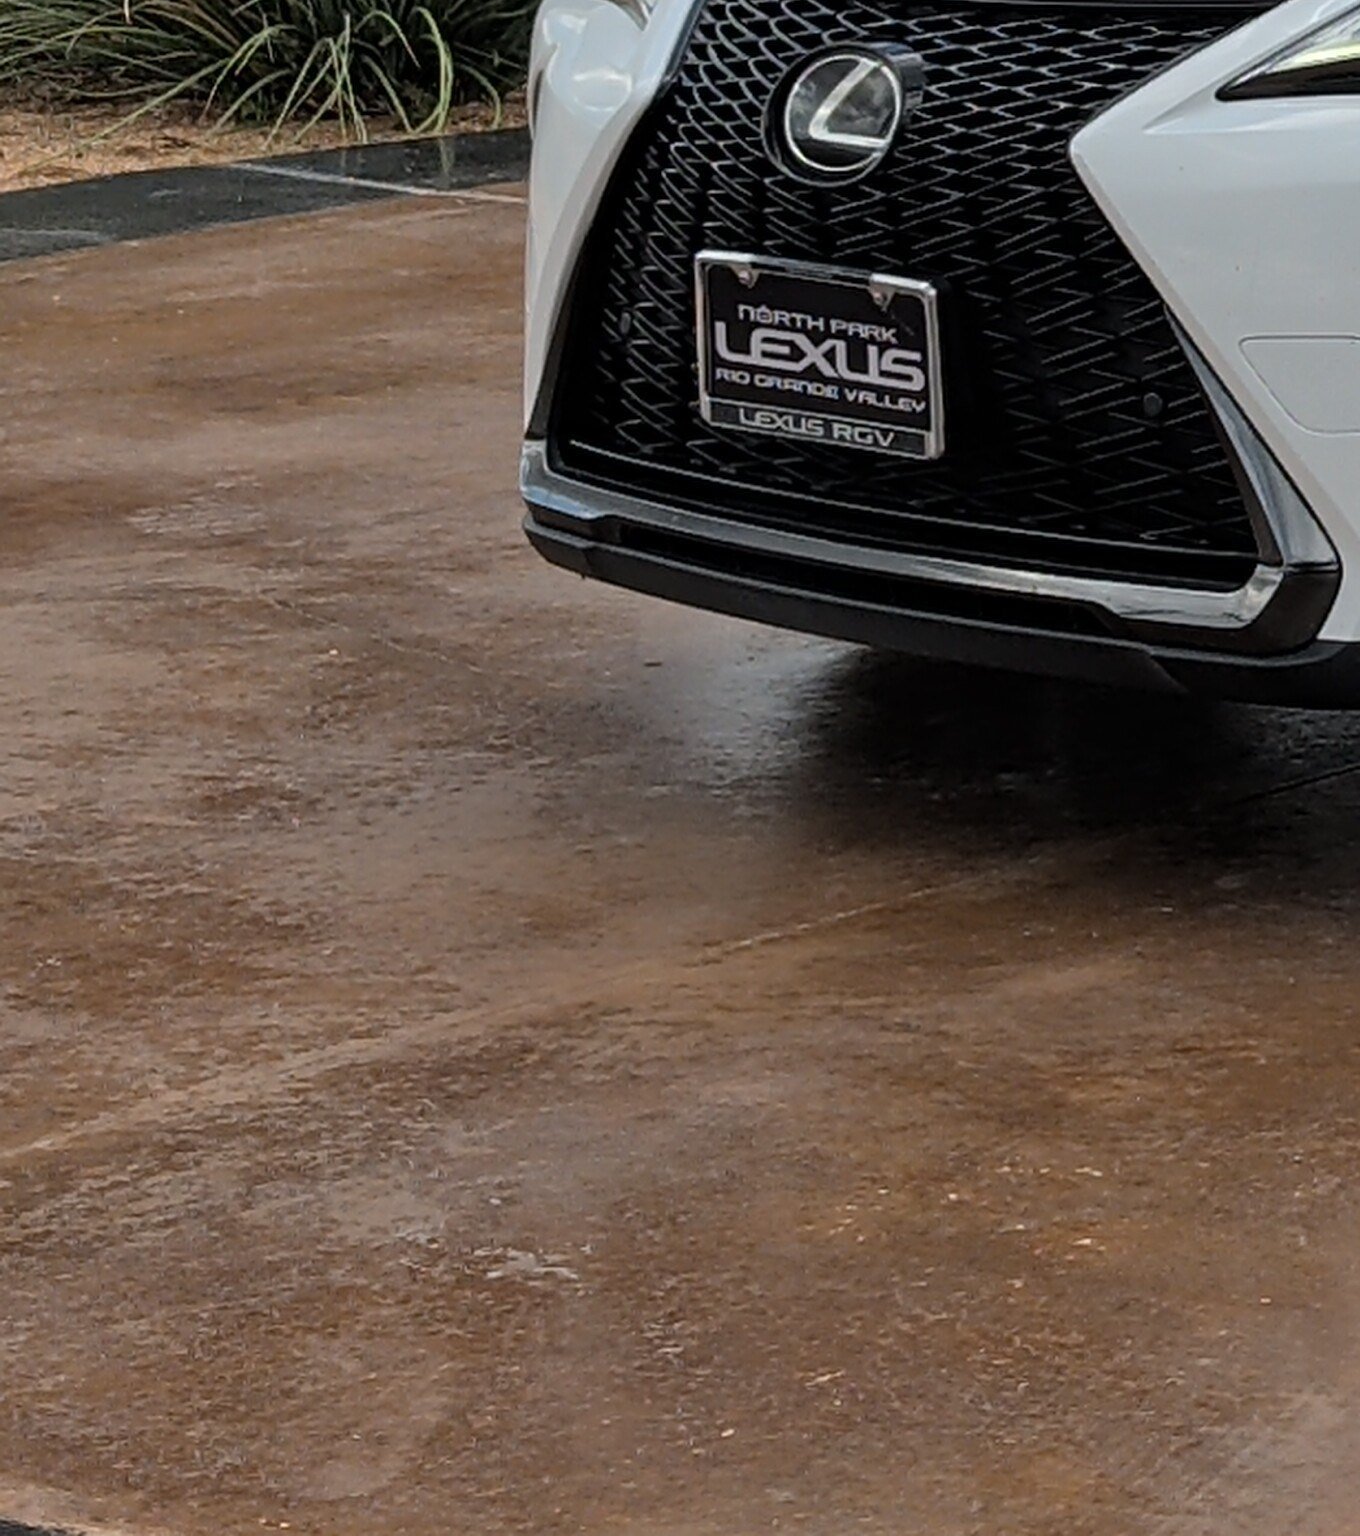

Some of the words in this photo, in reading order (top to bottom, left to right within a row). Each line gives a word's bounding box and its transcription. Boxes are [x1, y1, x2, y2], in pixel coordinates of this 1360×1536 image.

[737, 304, 825, 333] NORTH
[830, 317, 899, 345] PARK
[714, 320, 926, 392] LEXUS
[715, 367, 750, 385] RIO
[753, 373, 839, 400] GRANDE
[844, 388, 926, 414] VALLEY
[739, 407, 825, 437] LEXUS
[831, 422, 895, 448] RGV
